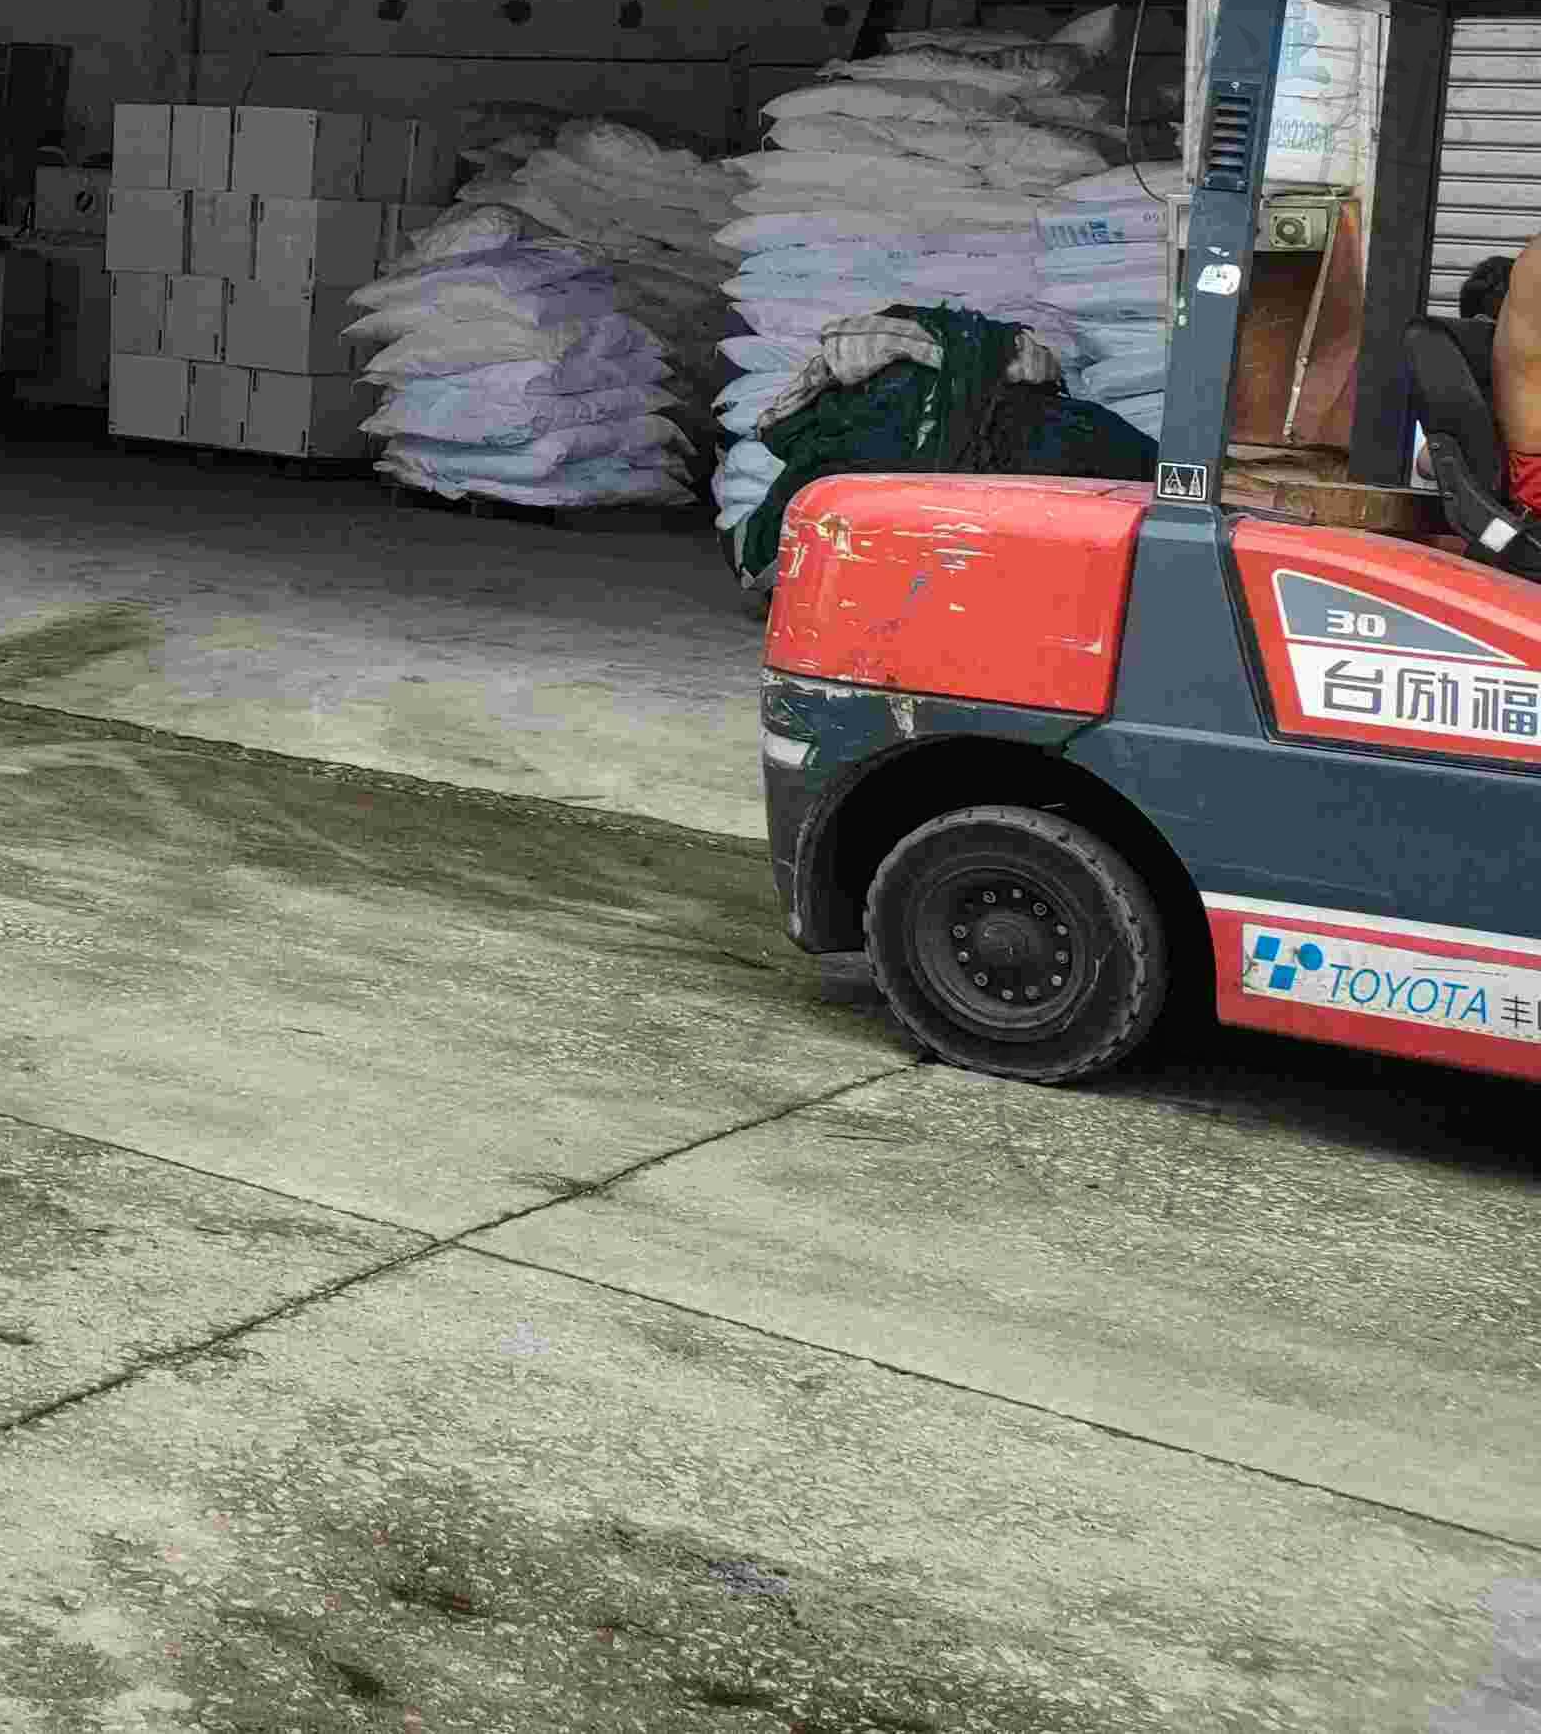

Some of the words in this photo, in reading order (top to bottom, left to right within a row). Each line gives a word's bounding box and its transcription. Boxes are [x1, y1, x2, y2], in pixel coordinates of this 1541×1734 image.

[1327, 609, 1387, 638] 30
[1324, 659, 1541, 736] 台励福
[1327, 963, 1487, 1024] TOYOTA
[1500, 995, 1541, 1029] 丰
